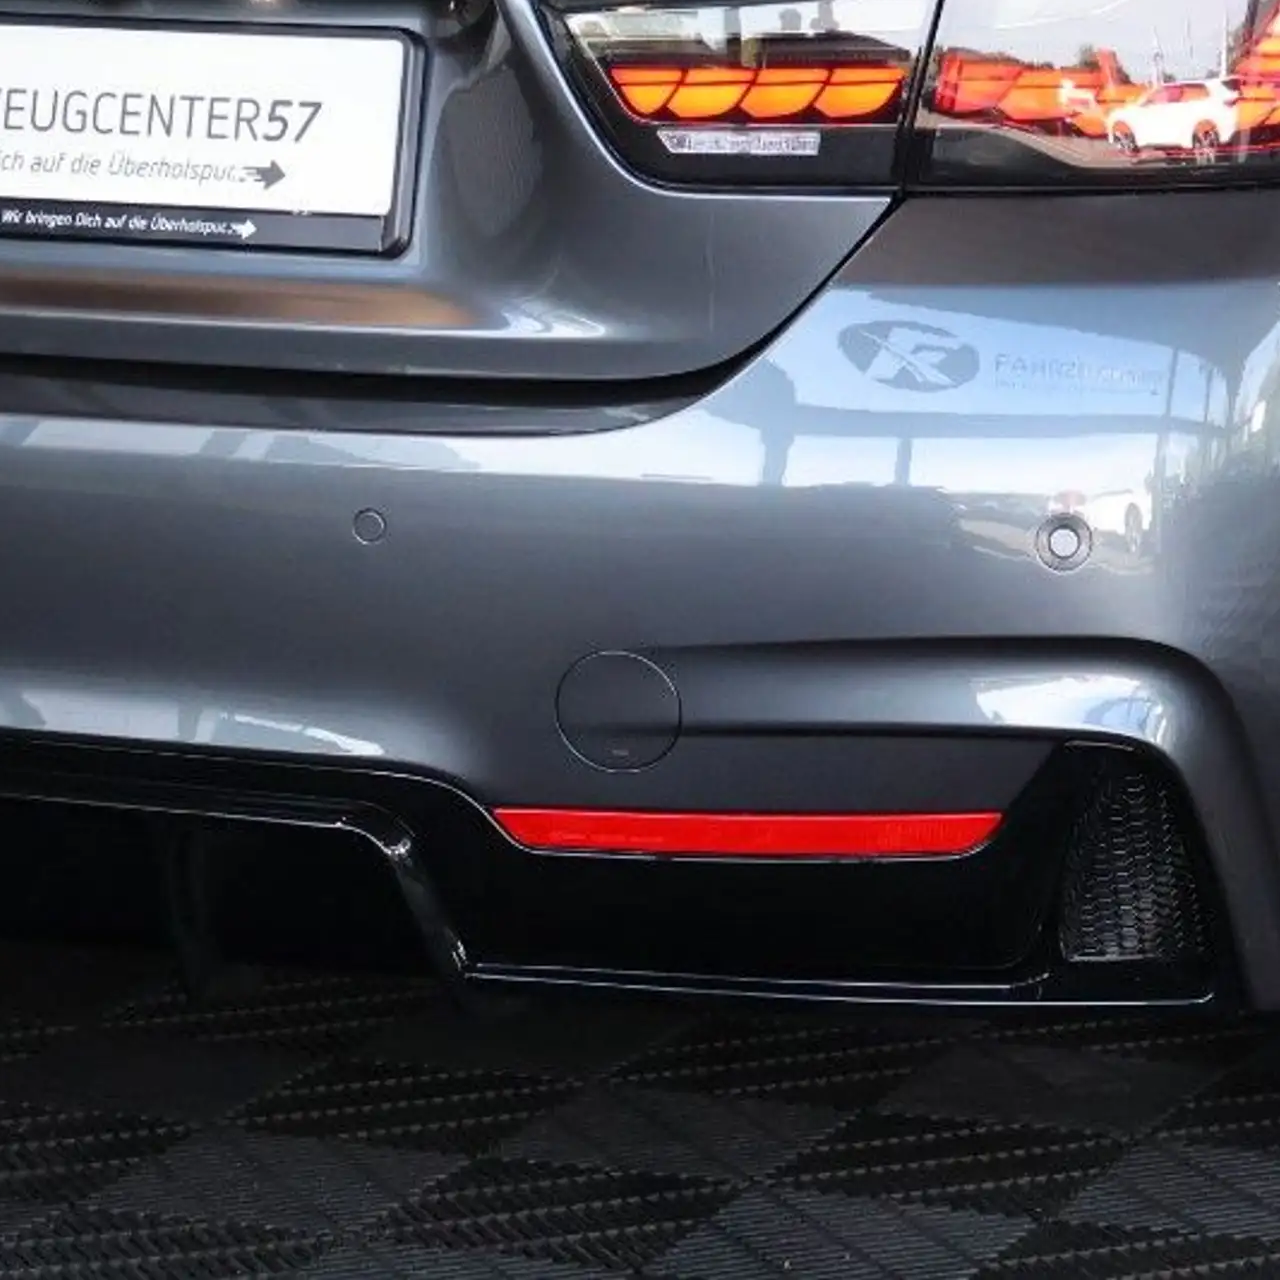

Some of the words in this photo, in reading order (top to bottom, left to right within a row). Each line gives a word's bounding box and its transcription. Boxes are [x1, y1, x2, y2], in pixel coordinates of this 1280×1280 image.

[29, 153, 66, 173] auf
[70, 153, 102, 176] die
[1, 209, 23, 224] Wir
[25, 210, 72, 228] bringen
[74, 212, 101, 228] Dich
[104, 214, 128, 229] auf
